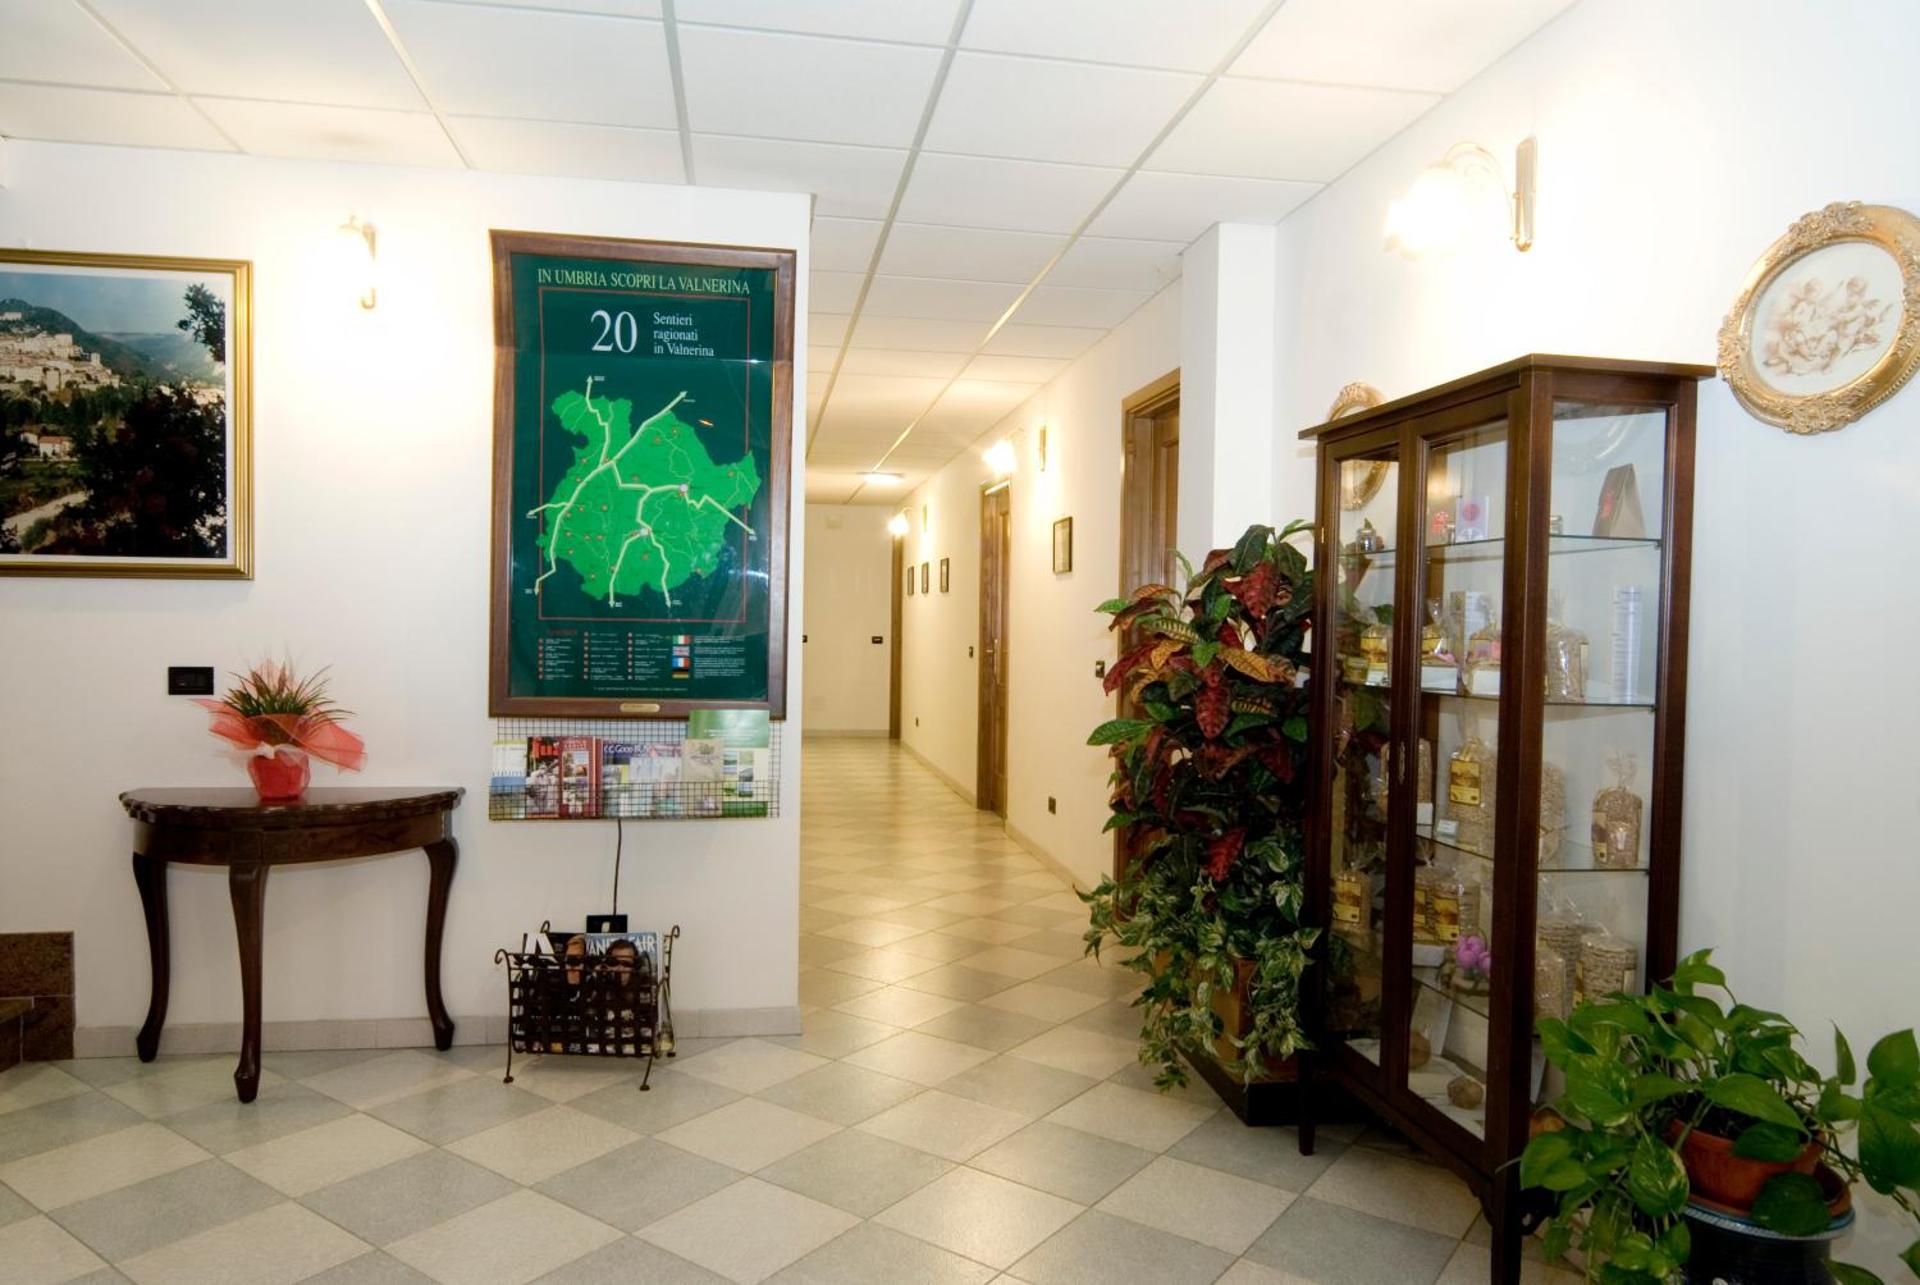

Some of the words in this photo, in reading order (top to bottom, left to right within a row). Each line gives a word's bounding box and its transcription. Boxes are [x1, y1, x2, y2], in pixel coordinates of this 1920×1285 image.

[537, 268, 551, 283] IN
[554, 269, 608, 287] UMBRIA
[610, 273, 656, 289] SCOPRI
[659, 275, 676, 291] LA
[678, 276, 750, 295] VALNERINA
[653, 311, 693, 326] Sentieri
[590, 309, 638, 353] 20
[653, 328, 698, 343] ragionati
[653, 341, 664, 354] in
[667, 342, 715, 357] Valnerina
